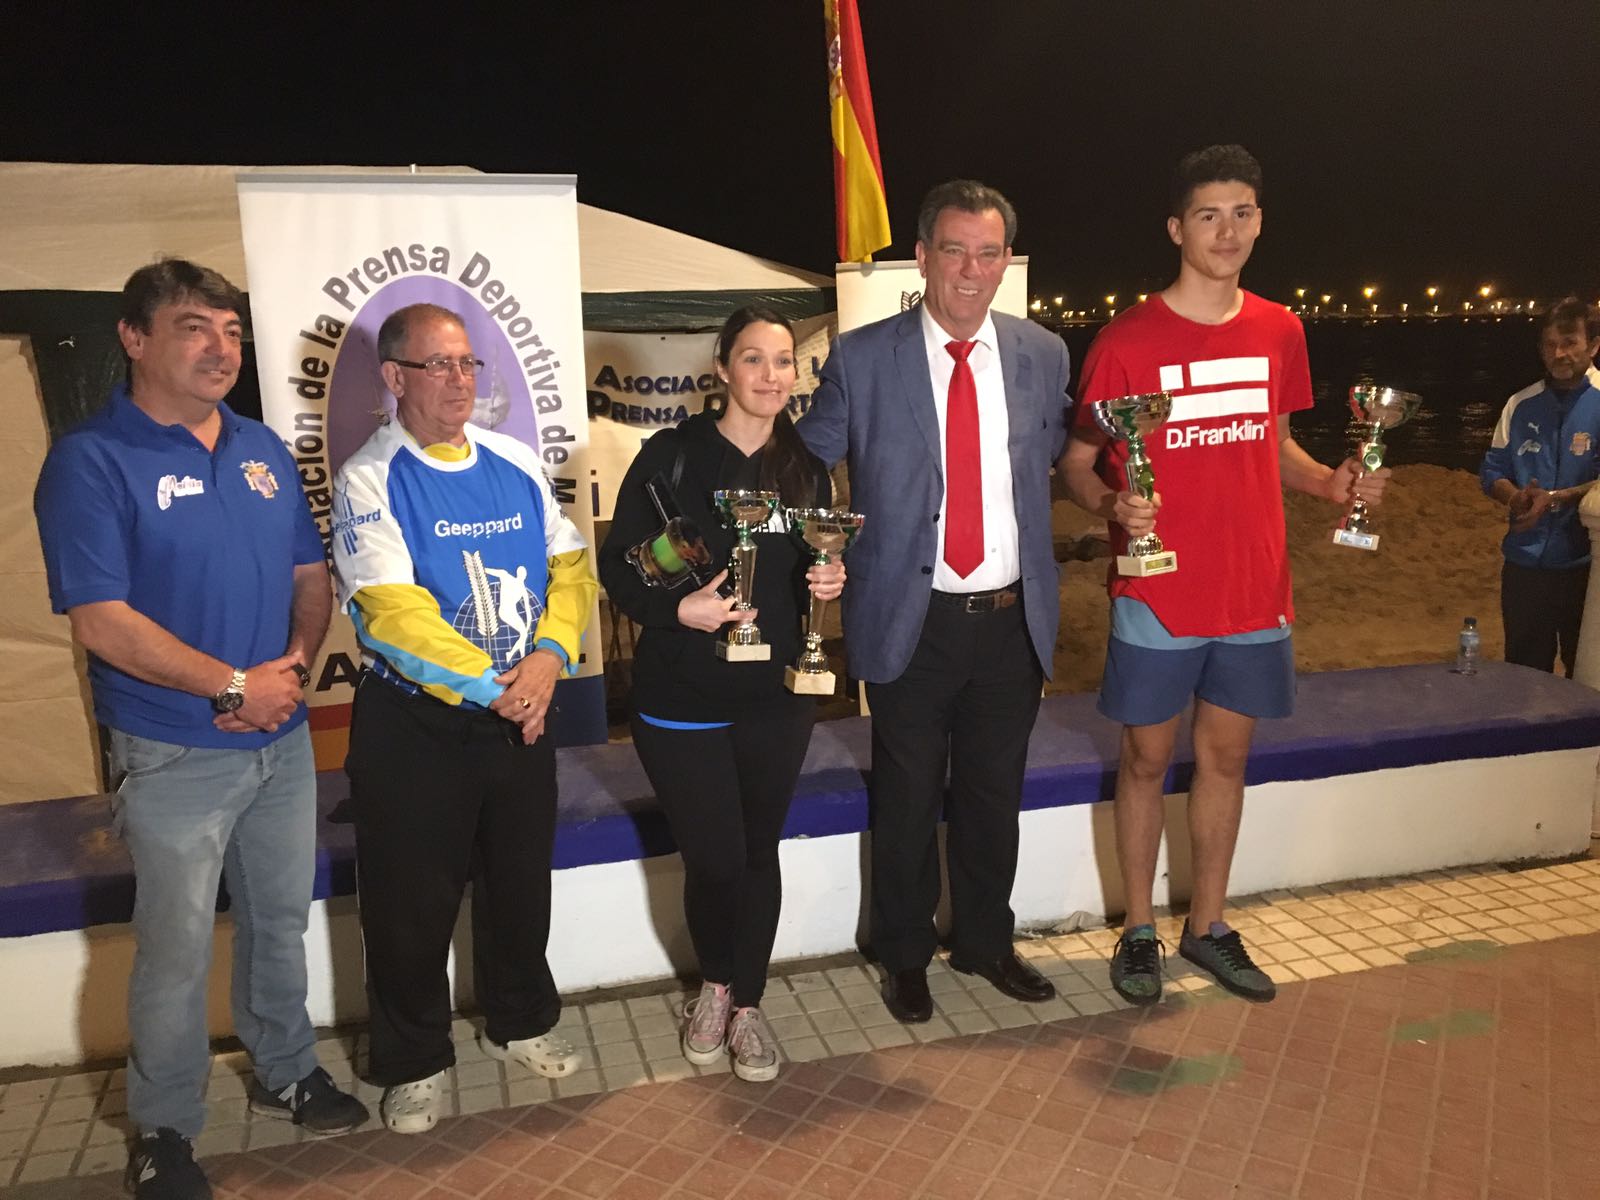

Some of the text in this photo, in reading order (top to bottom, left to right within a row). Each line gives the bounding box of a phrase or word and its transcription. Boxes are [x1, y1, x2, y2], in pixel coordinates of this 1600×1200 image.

[322, 243, 452, 311] Prensa
[298, 311, 347, 351] la
[457, 251, 564, 415] Deportiva
[287, 355, 330, 402] de
[593, 364, 719, 396] ASOCIACI
[540, 424, 577, 466] de
[1165, 419, 1266, 450] D.Franklin
[285, 412, 332, 556] ciación
[552, 477, 577, 504] M
[434, 512, 523, 539] Geeppard
